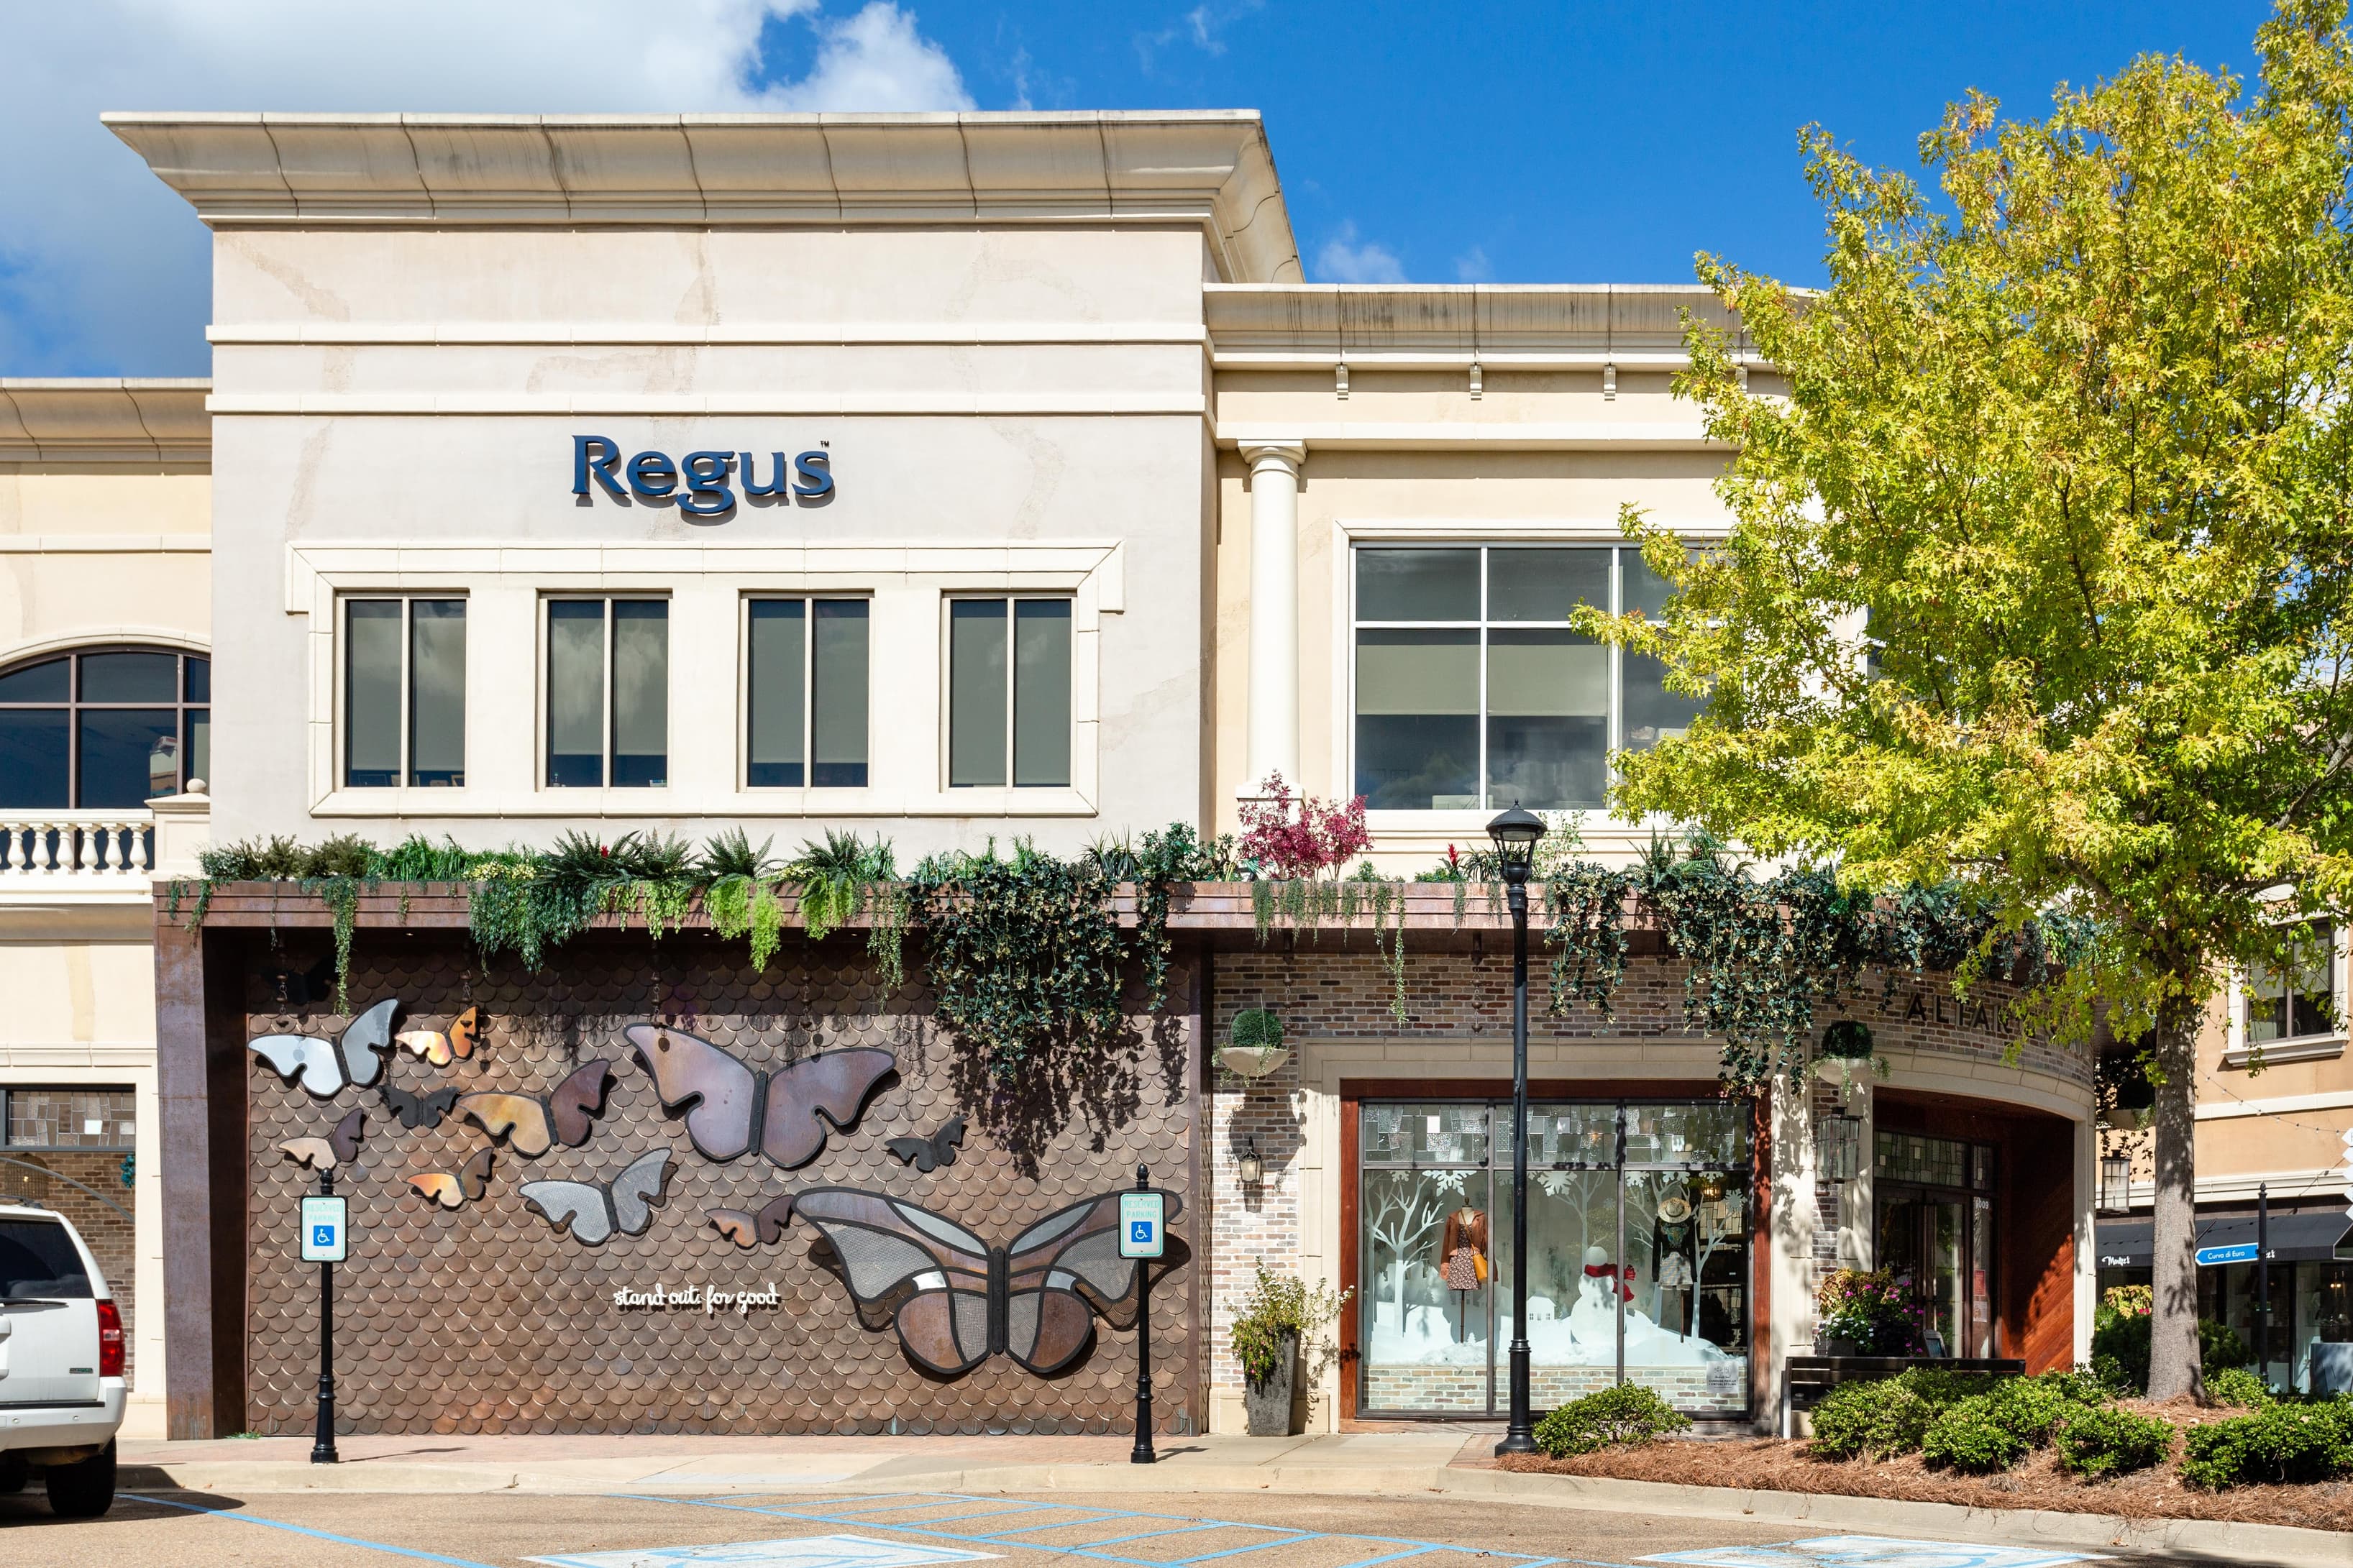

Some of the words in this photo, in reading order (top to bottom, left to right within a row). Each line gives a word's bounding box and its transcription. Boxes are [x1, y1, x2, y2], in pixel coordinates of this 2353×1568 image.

[572, 435, 834, 514] Regus
[613, 1283, 666, 1306] stand
[706, 1285, 736, 1314] for
